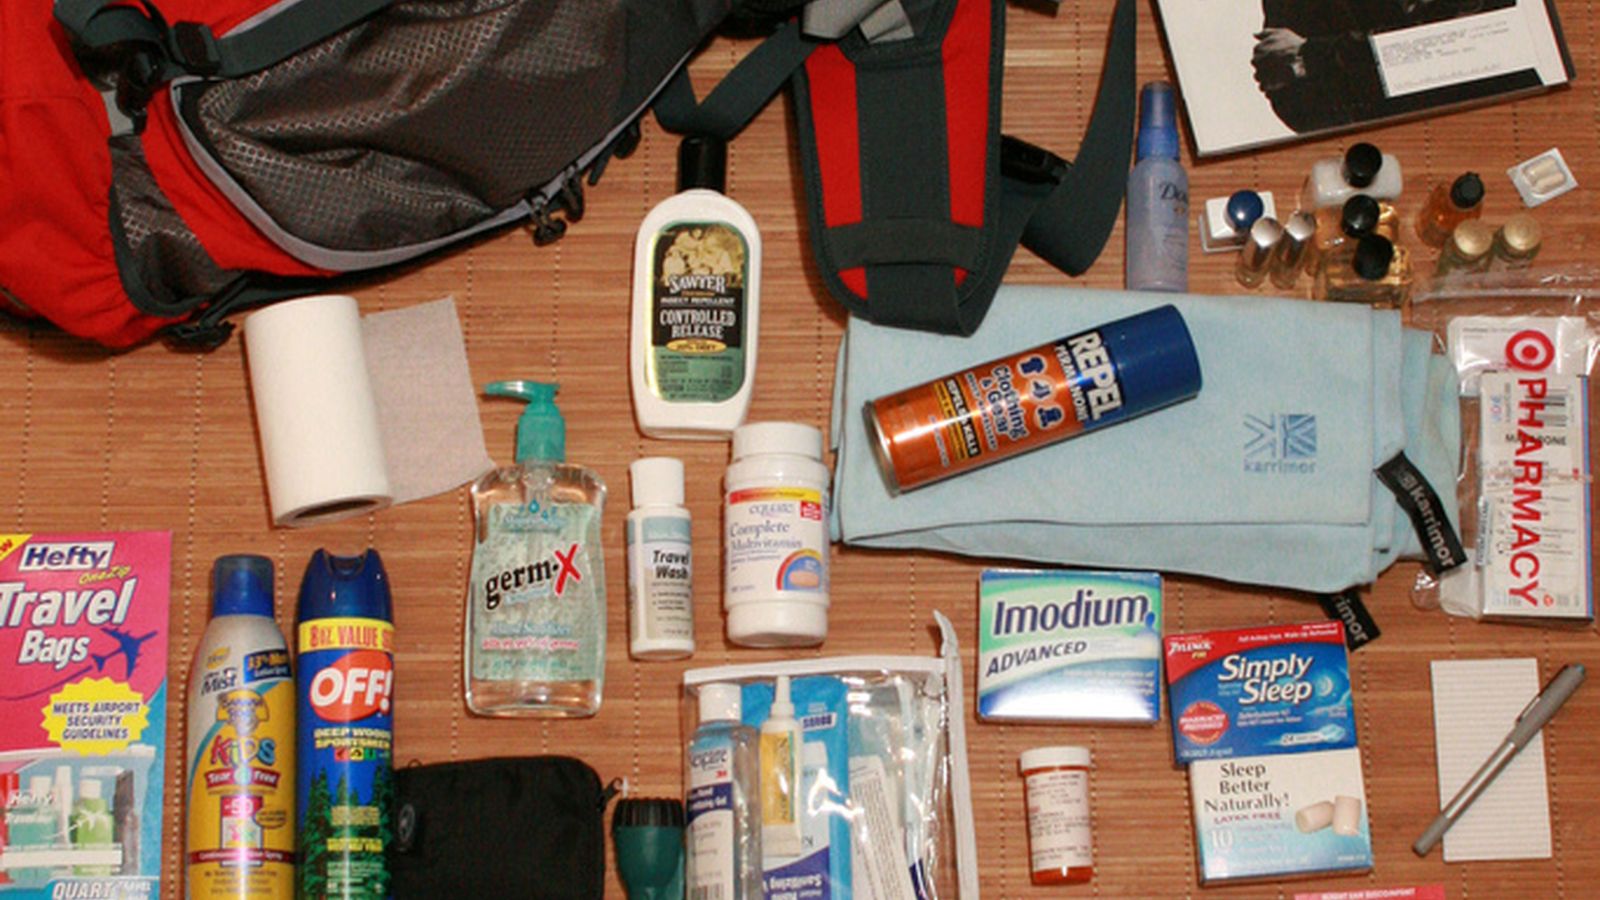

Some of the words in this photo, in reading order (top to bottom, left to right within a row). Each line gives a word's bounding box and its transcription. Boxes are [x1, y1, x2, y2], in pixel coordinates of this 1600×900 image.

[669, 274, 726, 293] SAWYER
[660, 309, 736, 326] CONTROLLED
[672, 324, 724, 339] RELEASE
[1069, 332, 1122, 420] REPEL
[988, 390, 1009, 434] Gear
[993, 365, 1028, 440] Clothing
[1243, 459, 1317, 474] karrimor
[1509, 378, 1547, 607] PHARMACY
[730, 519, 790, 538] Complete
[1410, 486, 1455, 568] karrimor
[730, 538, 803, 550] Multivitamin
[24, 546, 108, 569] Hefty
[652, 549, 690, 565] Travel
[655, 565, 689, 579] Wash
[0, 575, 138, 627] Travel
[993, 588, 1149, 636] Imodium
[338, 625, 378, 646] VALUE
[18, 629, 91, 670] Bags
[985, 640, 1088, 677] ADVANCED
[1217, 653, 1314, 682] Simply
[310, 667, 393, 712] OFF!
[1238, 678, 1313, 704] Sleep
[53, 703, 89, 713] MEETS
[92, 702, 141, 713] AIRPORT
[67, 716, 123, 727] SECURITY
[62, 728, 129, 740] GUIDELINES
[314, 727, 350, 739] DEEP
[1220, 762, 1266, 778] Sleep
[1219, 779, 1270, 795] Better
[1204, 792, 1290, 813] Naturally!
[1213, 815, 1250, 825] LATEX
[1252, 812, 1282, 821] FREE
[52, 881, 113, 900] QUART
